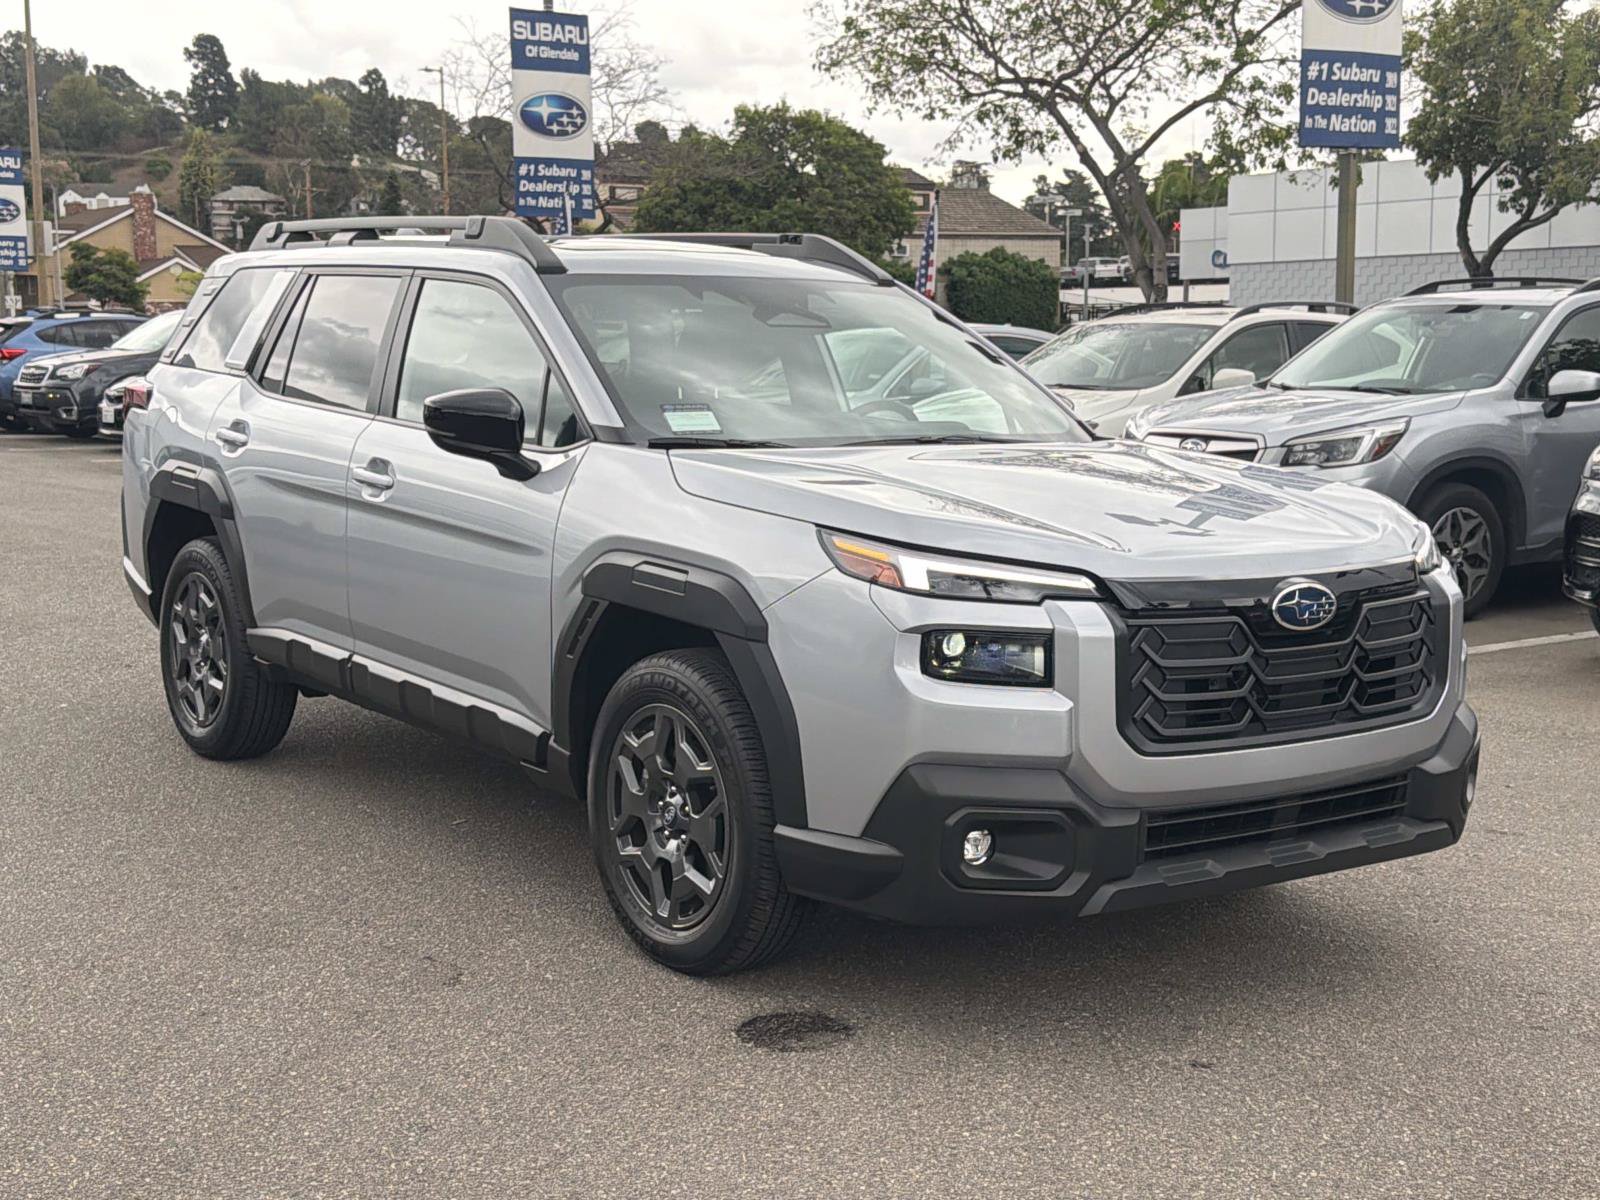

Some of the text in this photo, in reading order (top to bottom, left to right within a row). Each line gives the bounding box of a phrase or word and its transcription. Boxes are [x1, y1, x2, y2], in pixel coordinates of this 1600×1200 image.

[512, 20, 588, 46] SUBARU
[525, 44, 580, 61] Of Glendale
[1306, 60, 1381, 83] #1 Subaru
[1306, 87, 1383, 113] Dealership
[1304, 113, 1377, 133] In The Nation
[518, 163, 535, 177] #1
[537, 163, 578, 178] Subaru
[537, 195, 576, 208] Natin
